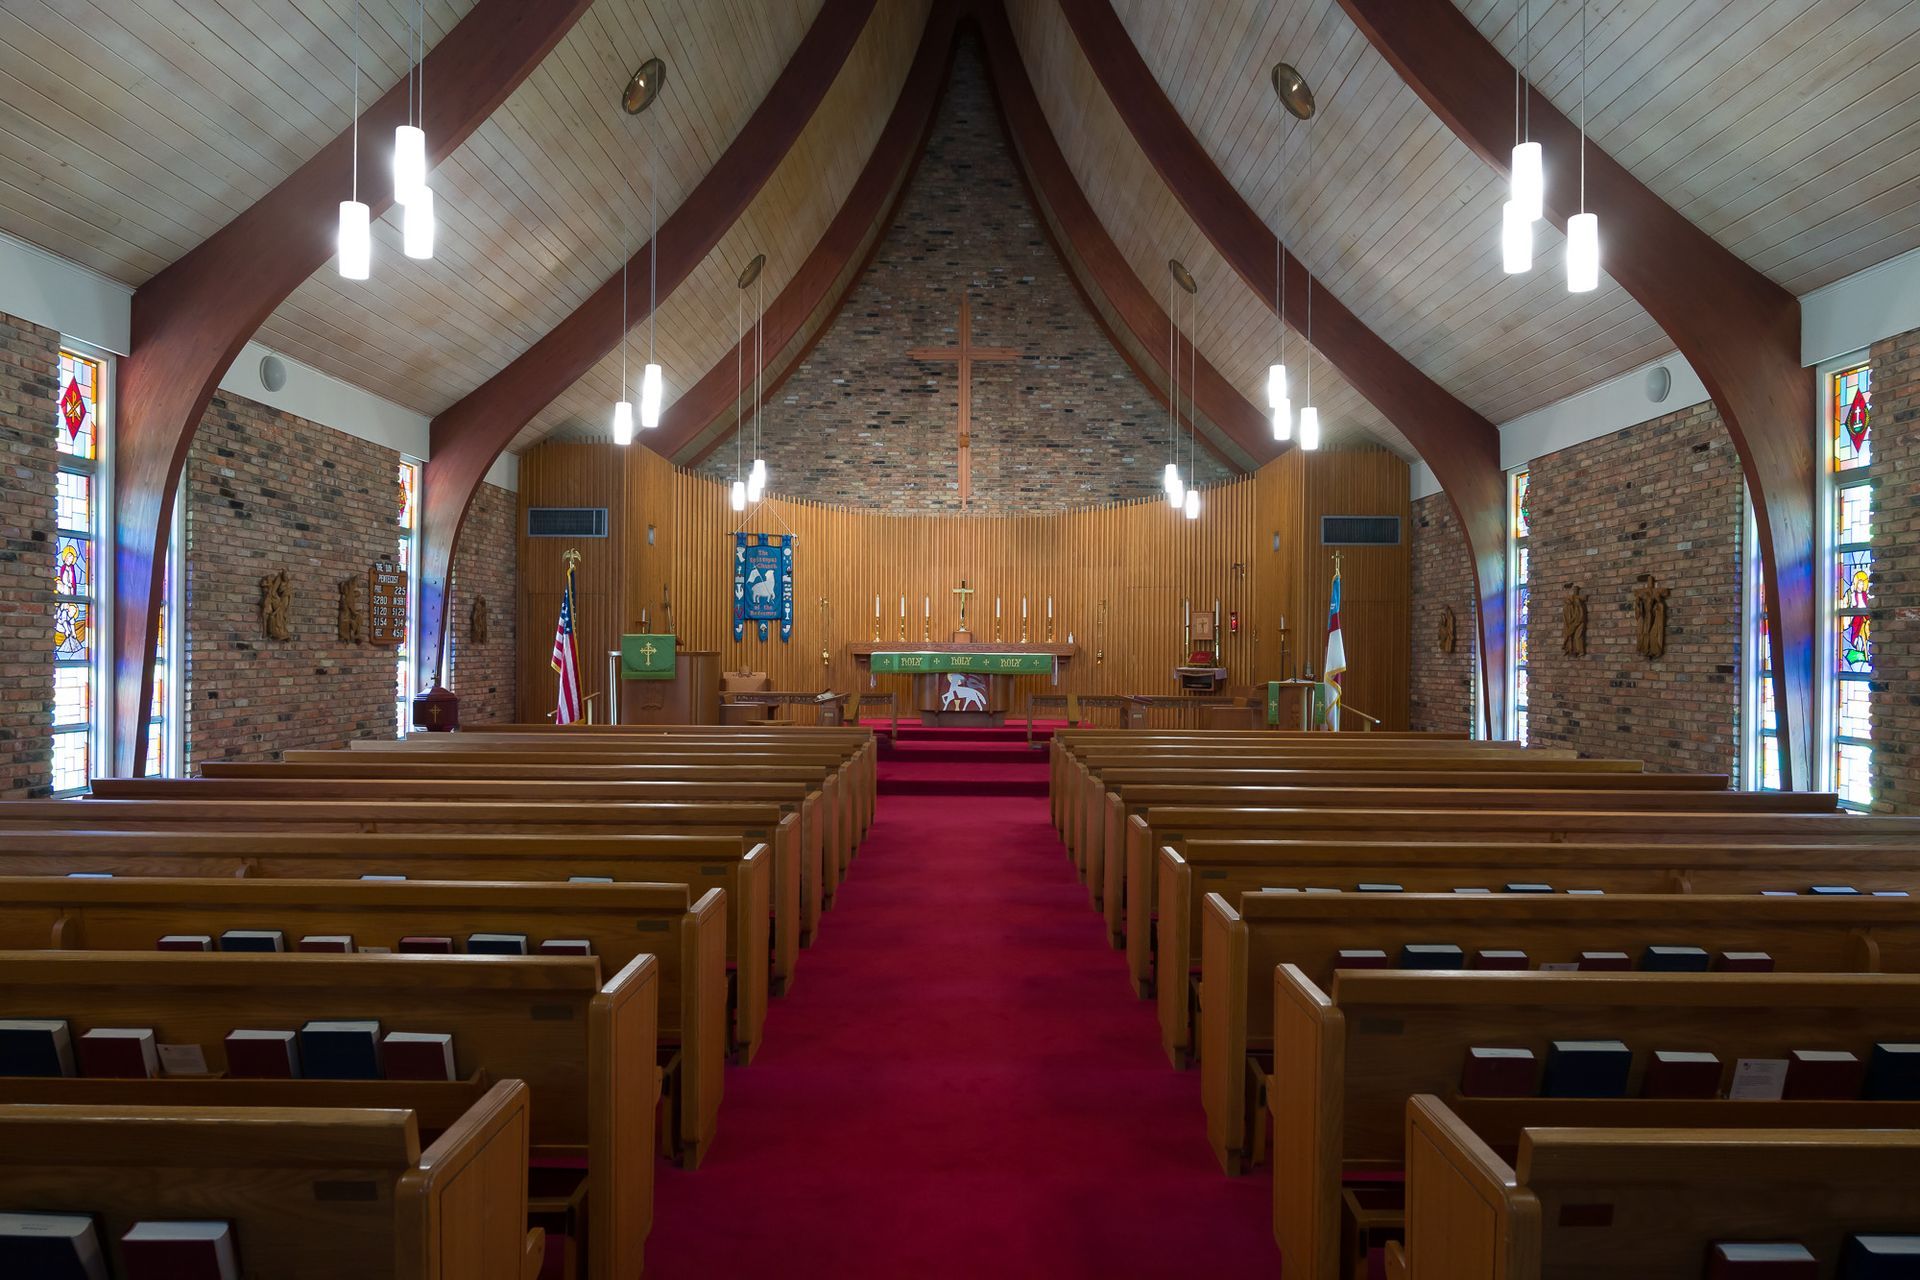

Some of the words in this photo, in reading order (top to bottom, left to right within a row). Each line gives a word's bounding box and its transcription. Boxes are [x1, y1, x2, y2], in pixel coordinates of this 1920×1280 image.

[394, 586, 406, 595] 225
[373, 595, 388, 605] S280
[373, 606, 388, 616] S120
[373, 617, 388, 627] S154
[394, 618, 405, 627] 314
[392, 629, 404, 638] 450
